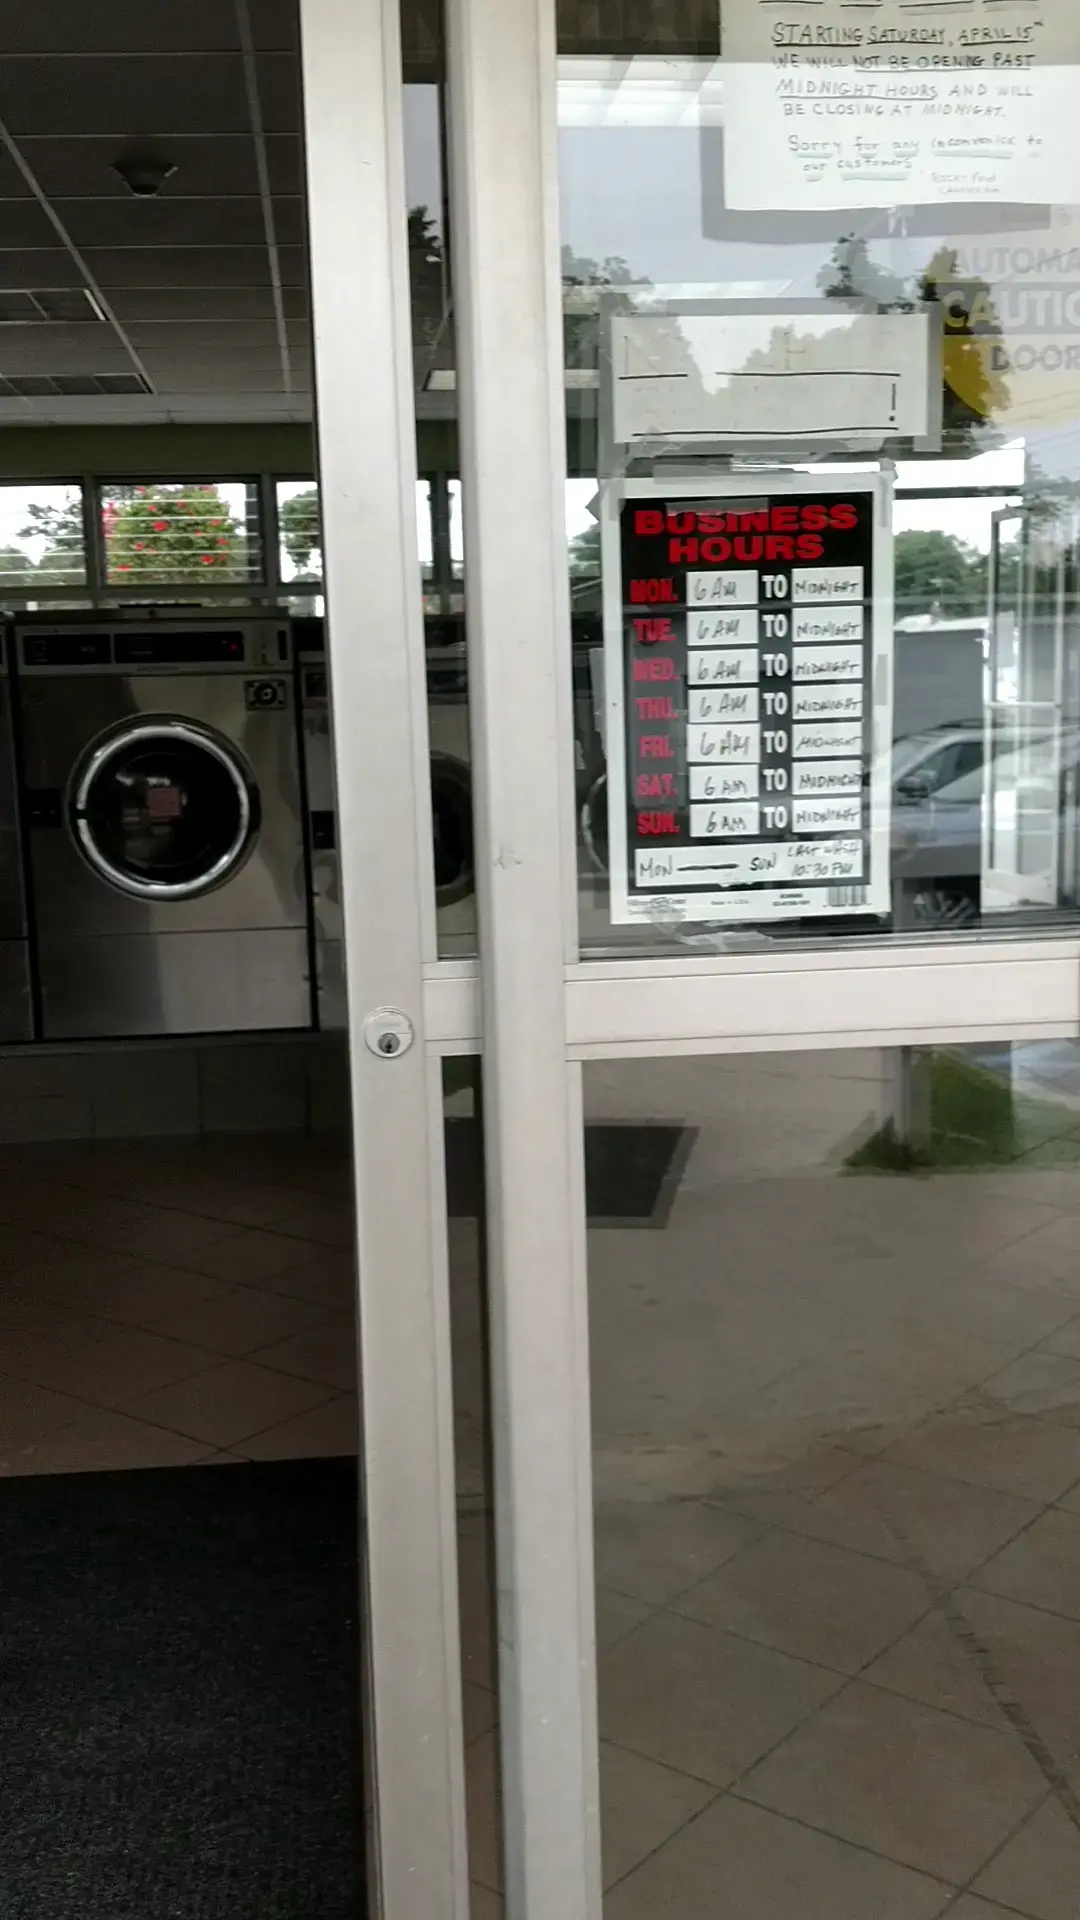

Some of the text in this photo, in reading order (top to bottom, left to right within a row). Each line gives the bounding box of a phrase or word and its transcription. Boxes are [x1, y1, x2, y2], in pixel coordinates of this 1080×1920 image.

[771, 21, 864, 44] STARTING
[957, 26, 1012, 42] APRIL
[772, 51, 1036, 69] WE WILL NOT BE OPENING PAST
[776, 79, 1034, 98] MIDNIGHT HOURS AND WILL
[783, 103, 805, 116] BE
[812, 103, 884, 116] CLOSING
[890, 104, 912, 117] AT
[788, 133, 841, 154] Sorry
[634, 504, 858, 535] BUSINESS
[668, 534, 825, 564] HOURS
[694, 578, 707, 601] 6
[762, 574, 788, 598] TO
[697, 619, 710, 640] 6
[762, 614, 788, 638] TO
[698, 658, 709, 680] 6
[762, 653, 788, 677] TO
[700, 697, 712, 717] 6
[763, 692, 788, 715] TO
[700, 732, 715, 756] 6
[763, 730, 788, 753] TO
[704, 776, 715, 796] 6
[763, 768, 788, 791] TO
[706, 811, 717, 833] 6
[763, 806, 788, 829] TO
[750, 852, 777, 872] SUN
[787, 844, 822, 858] LAST
[831, 861, 854, 876] PM
